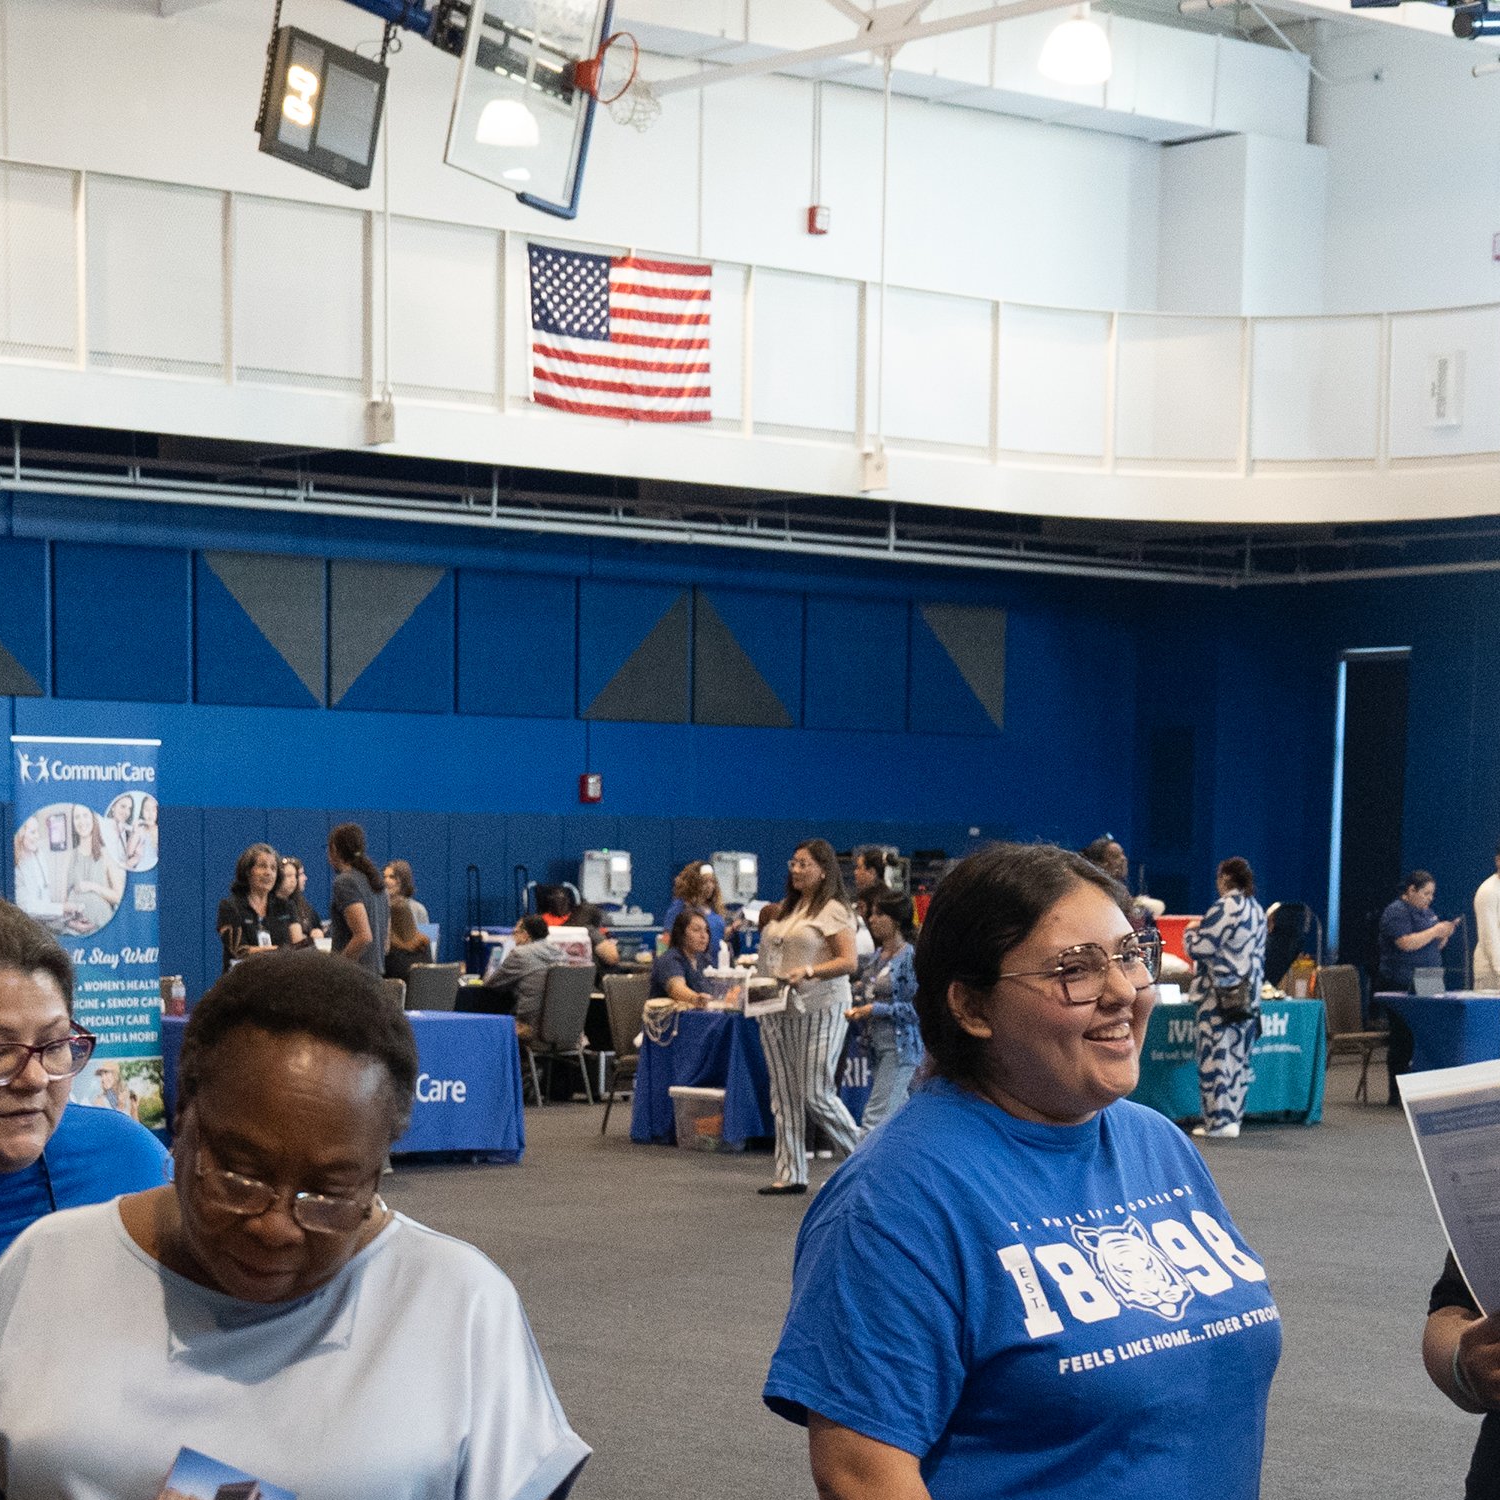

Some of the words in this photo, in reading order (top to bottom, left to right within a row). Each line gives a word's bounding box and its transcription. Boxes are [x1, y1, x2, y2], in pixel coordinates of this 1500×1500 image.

[51, 760, 156, 782] CommuniCare
[88, 947, 120, 969] Stay
[120, 947, 160, 964] Well!
[84, 980, 125, 991] WOMEN'S
[126, 980, 160, 990] HEALTH
[107, 997, 139, 1008] SENIOR
[80, 1014, 125, 1027] SPECIALTY
[126, 1013, 151, 1025] CARE
[1058, 1347, 1116, 1375] FEELS
[1117, 1338, 1153, 1360] LIKE
[1245, 1306, 1280, 1328] STRON
